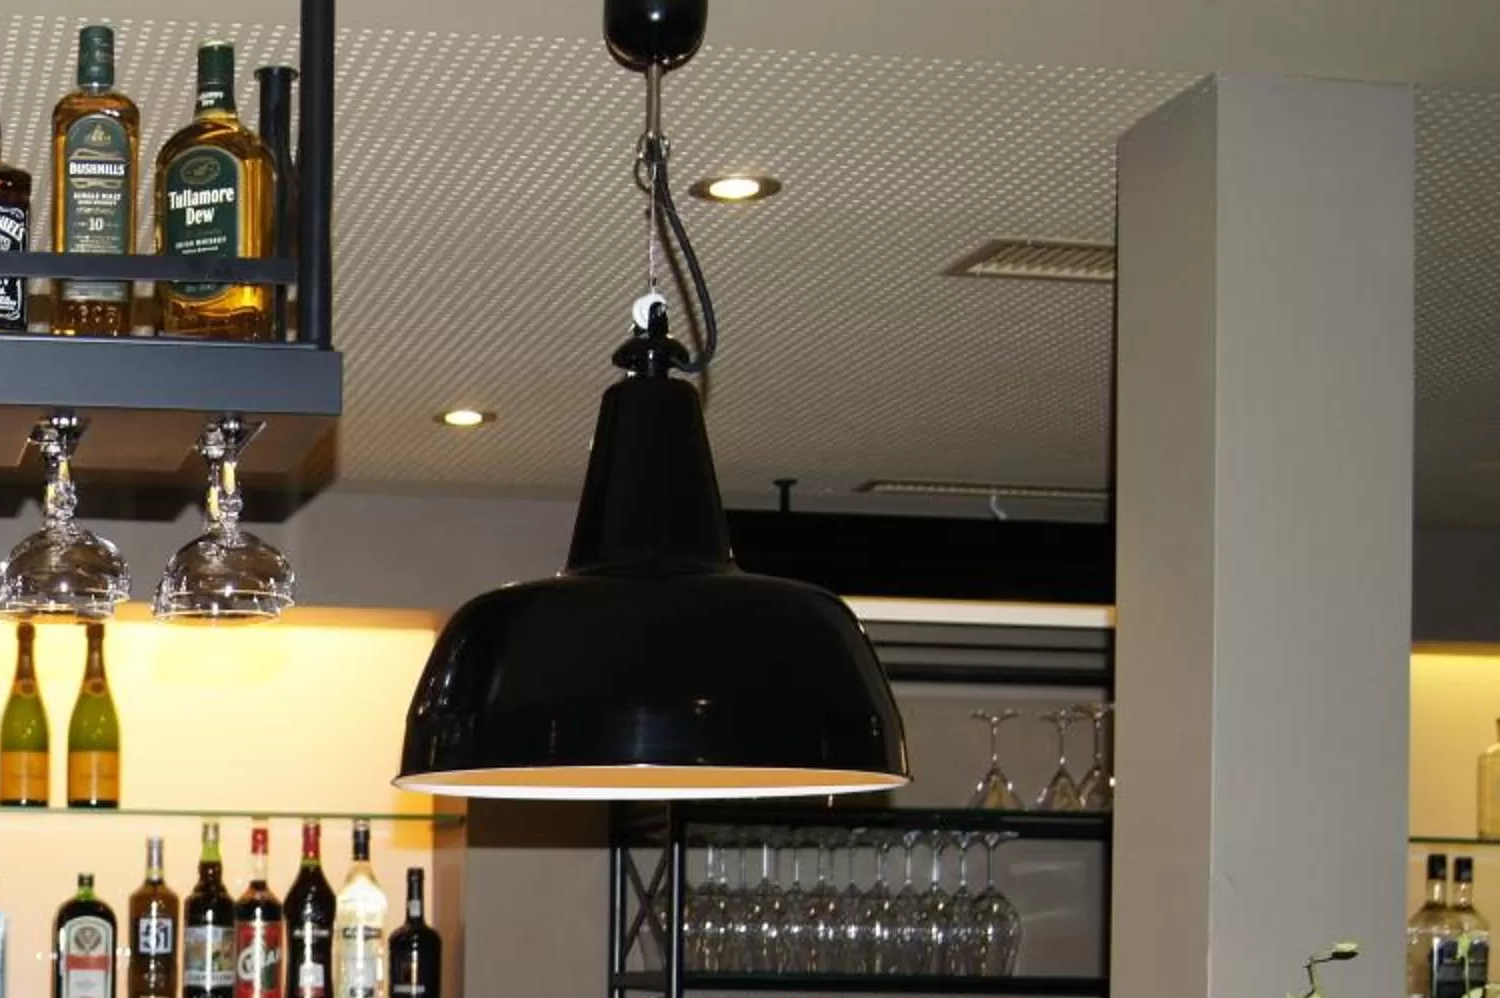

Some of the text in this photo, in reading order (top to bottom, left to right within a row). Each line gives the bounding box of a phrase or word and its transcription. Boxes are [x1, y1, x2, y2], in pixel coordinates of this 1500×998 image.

[68, 160, 126, 177] BUSHMILLS
[167, 186, 235, 211] Tullamore
[87, 216, 105, 232] 10
[184, 206, 216, 226] Dew
